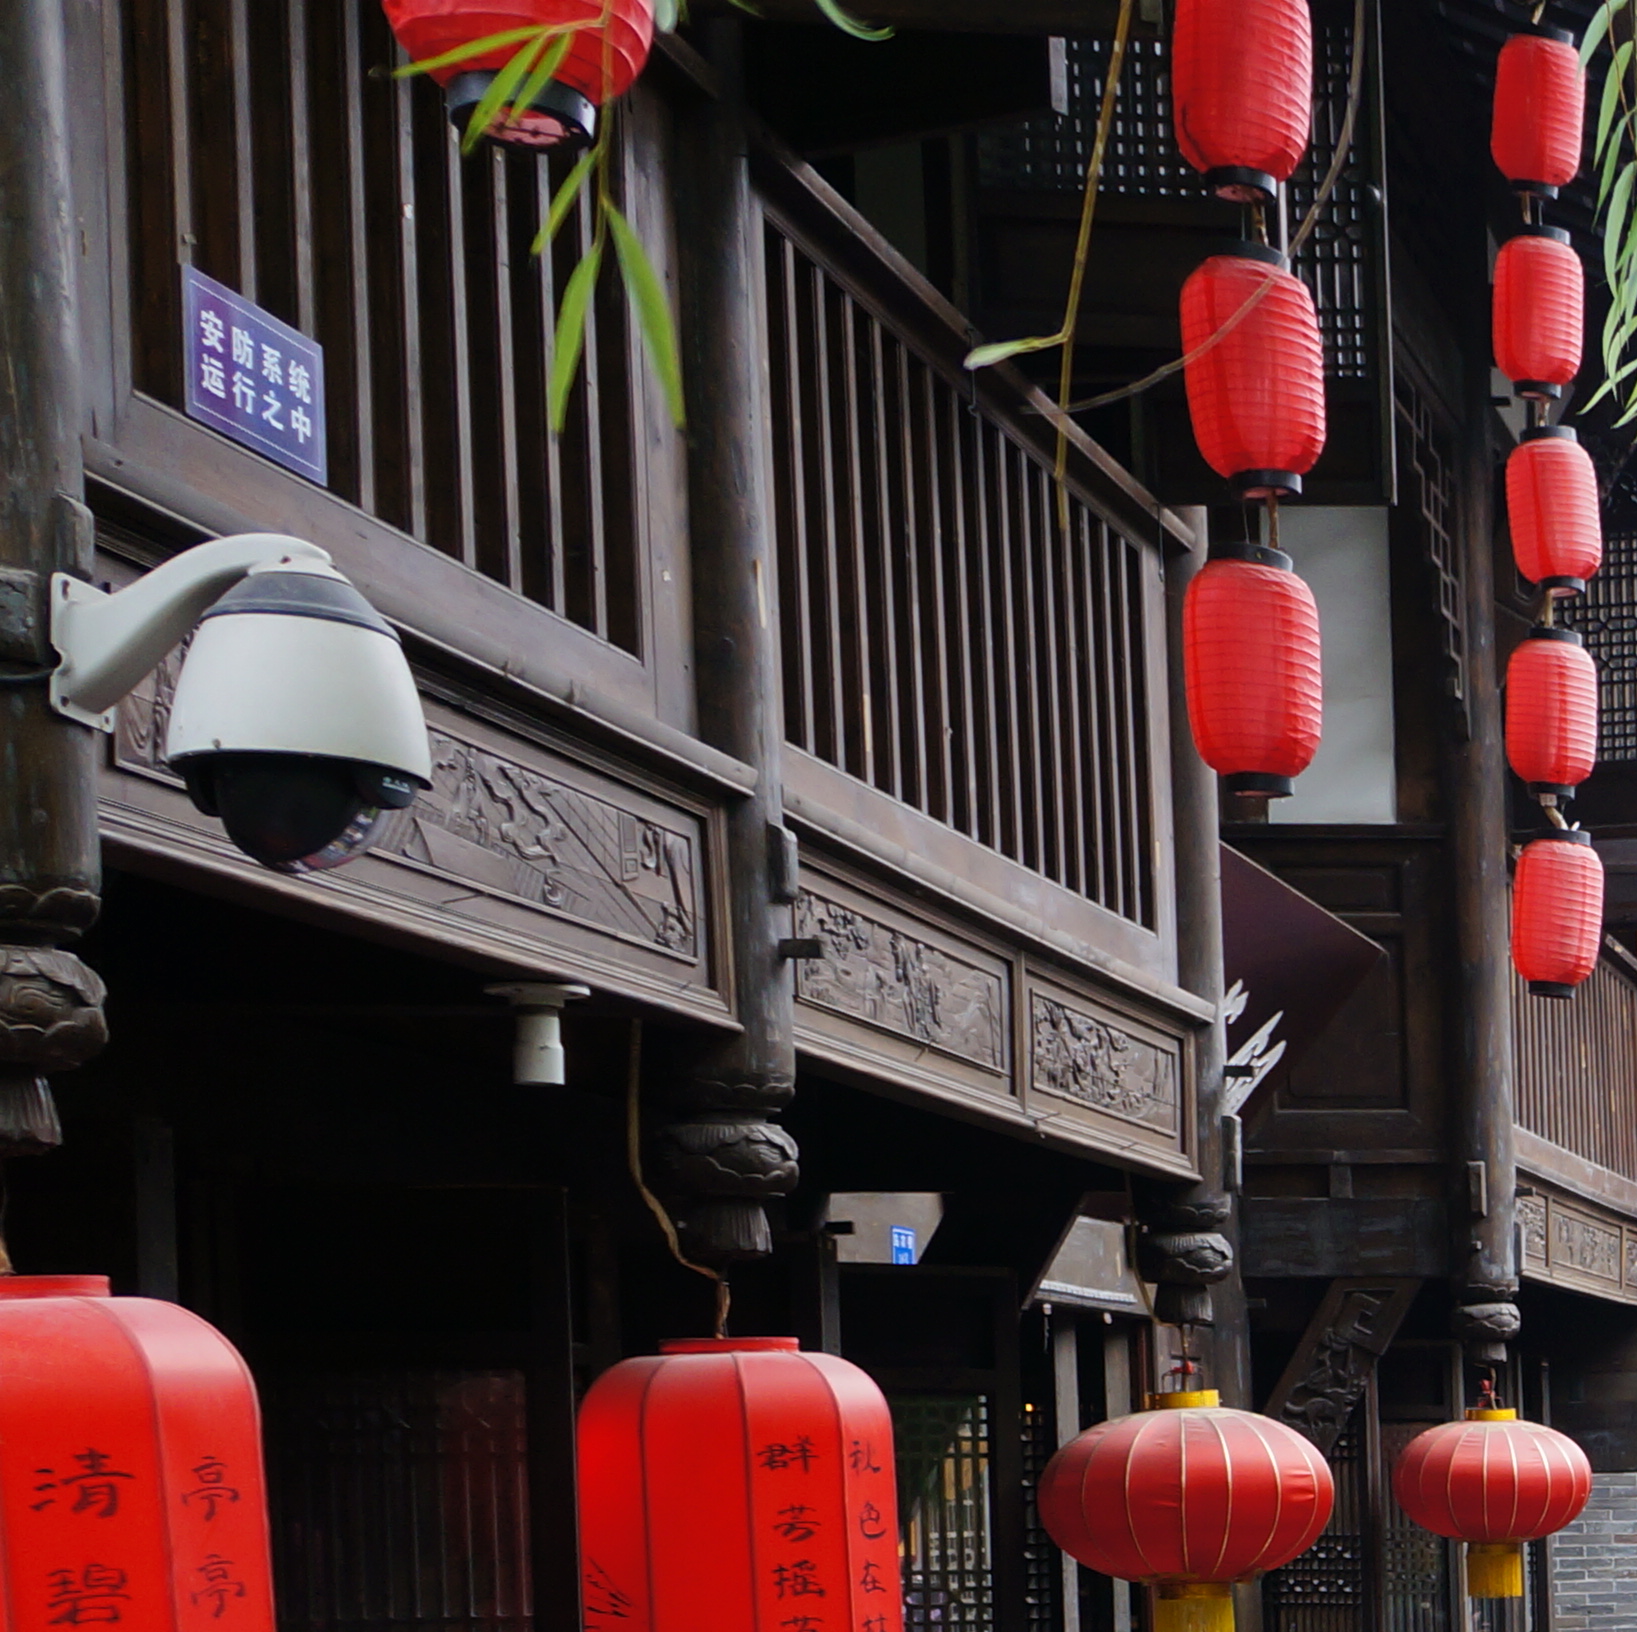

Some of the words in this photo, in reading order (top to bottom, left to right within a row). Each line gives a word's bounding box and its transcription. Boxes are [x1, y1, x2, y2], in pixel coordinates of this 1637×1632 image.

[200, 310, 312, 405] 安防系统
[200, 353, 313, 444] 运行之中
